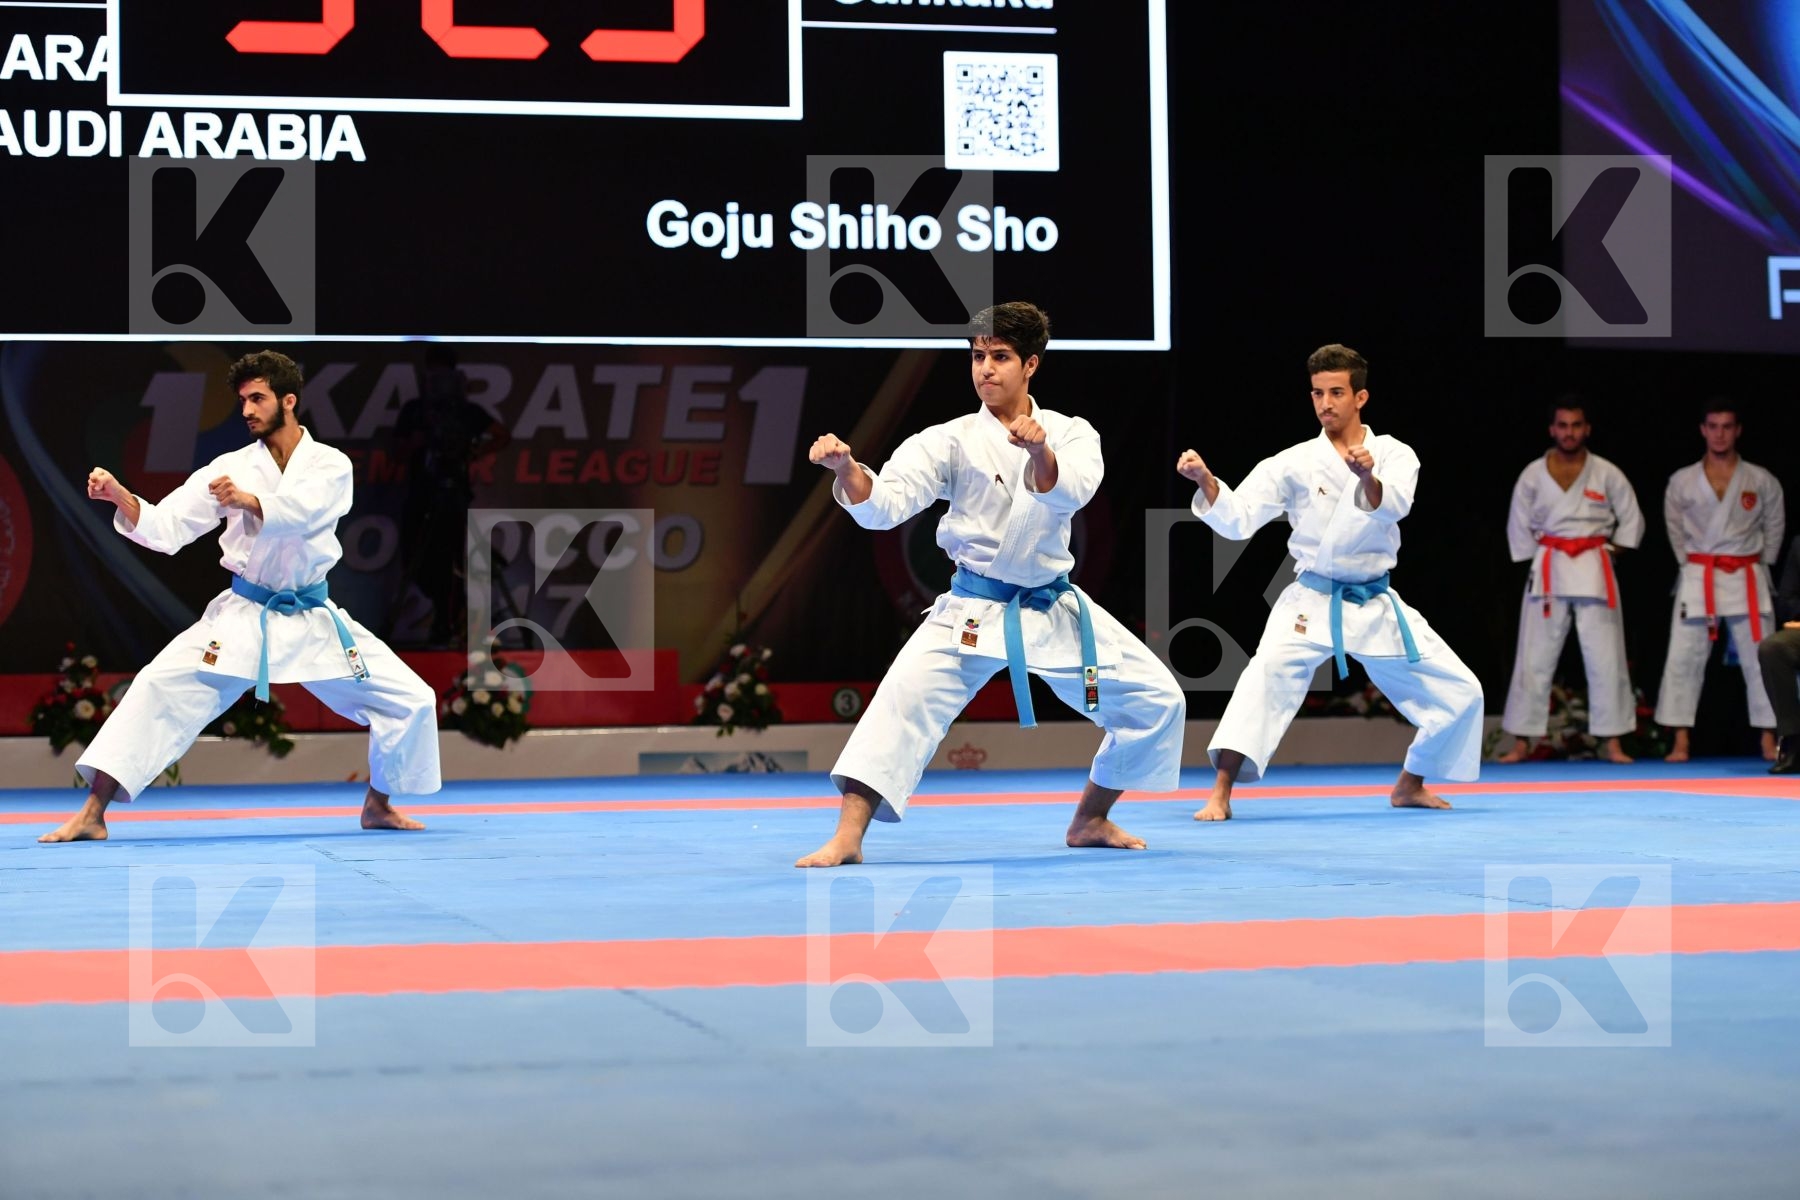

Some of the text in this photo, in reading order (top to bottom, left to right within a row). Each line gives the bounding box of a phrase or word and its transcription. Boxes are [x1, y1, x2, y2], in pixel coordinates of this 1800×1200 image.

[137, 112, 366, 161] ARABIA
[646, 199, 1059, 259] Goju Shiho Sho
[296, 363, 734, 441] KARATE
[737, 366, 808, 485] 1
[514, 448, 723, 485] LEAGUE
[839, 692, 854, 714] 3
